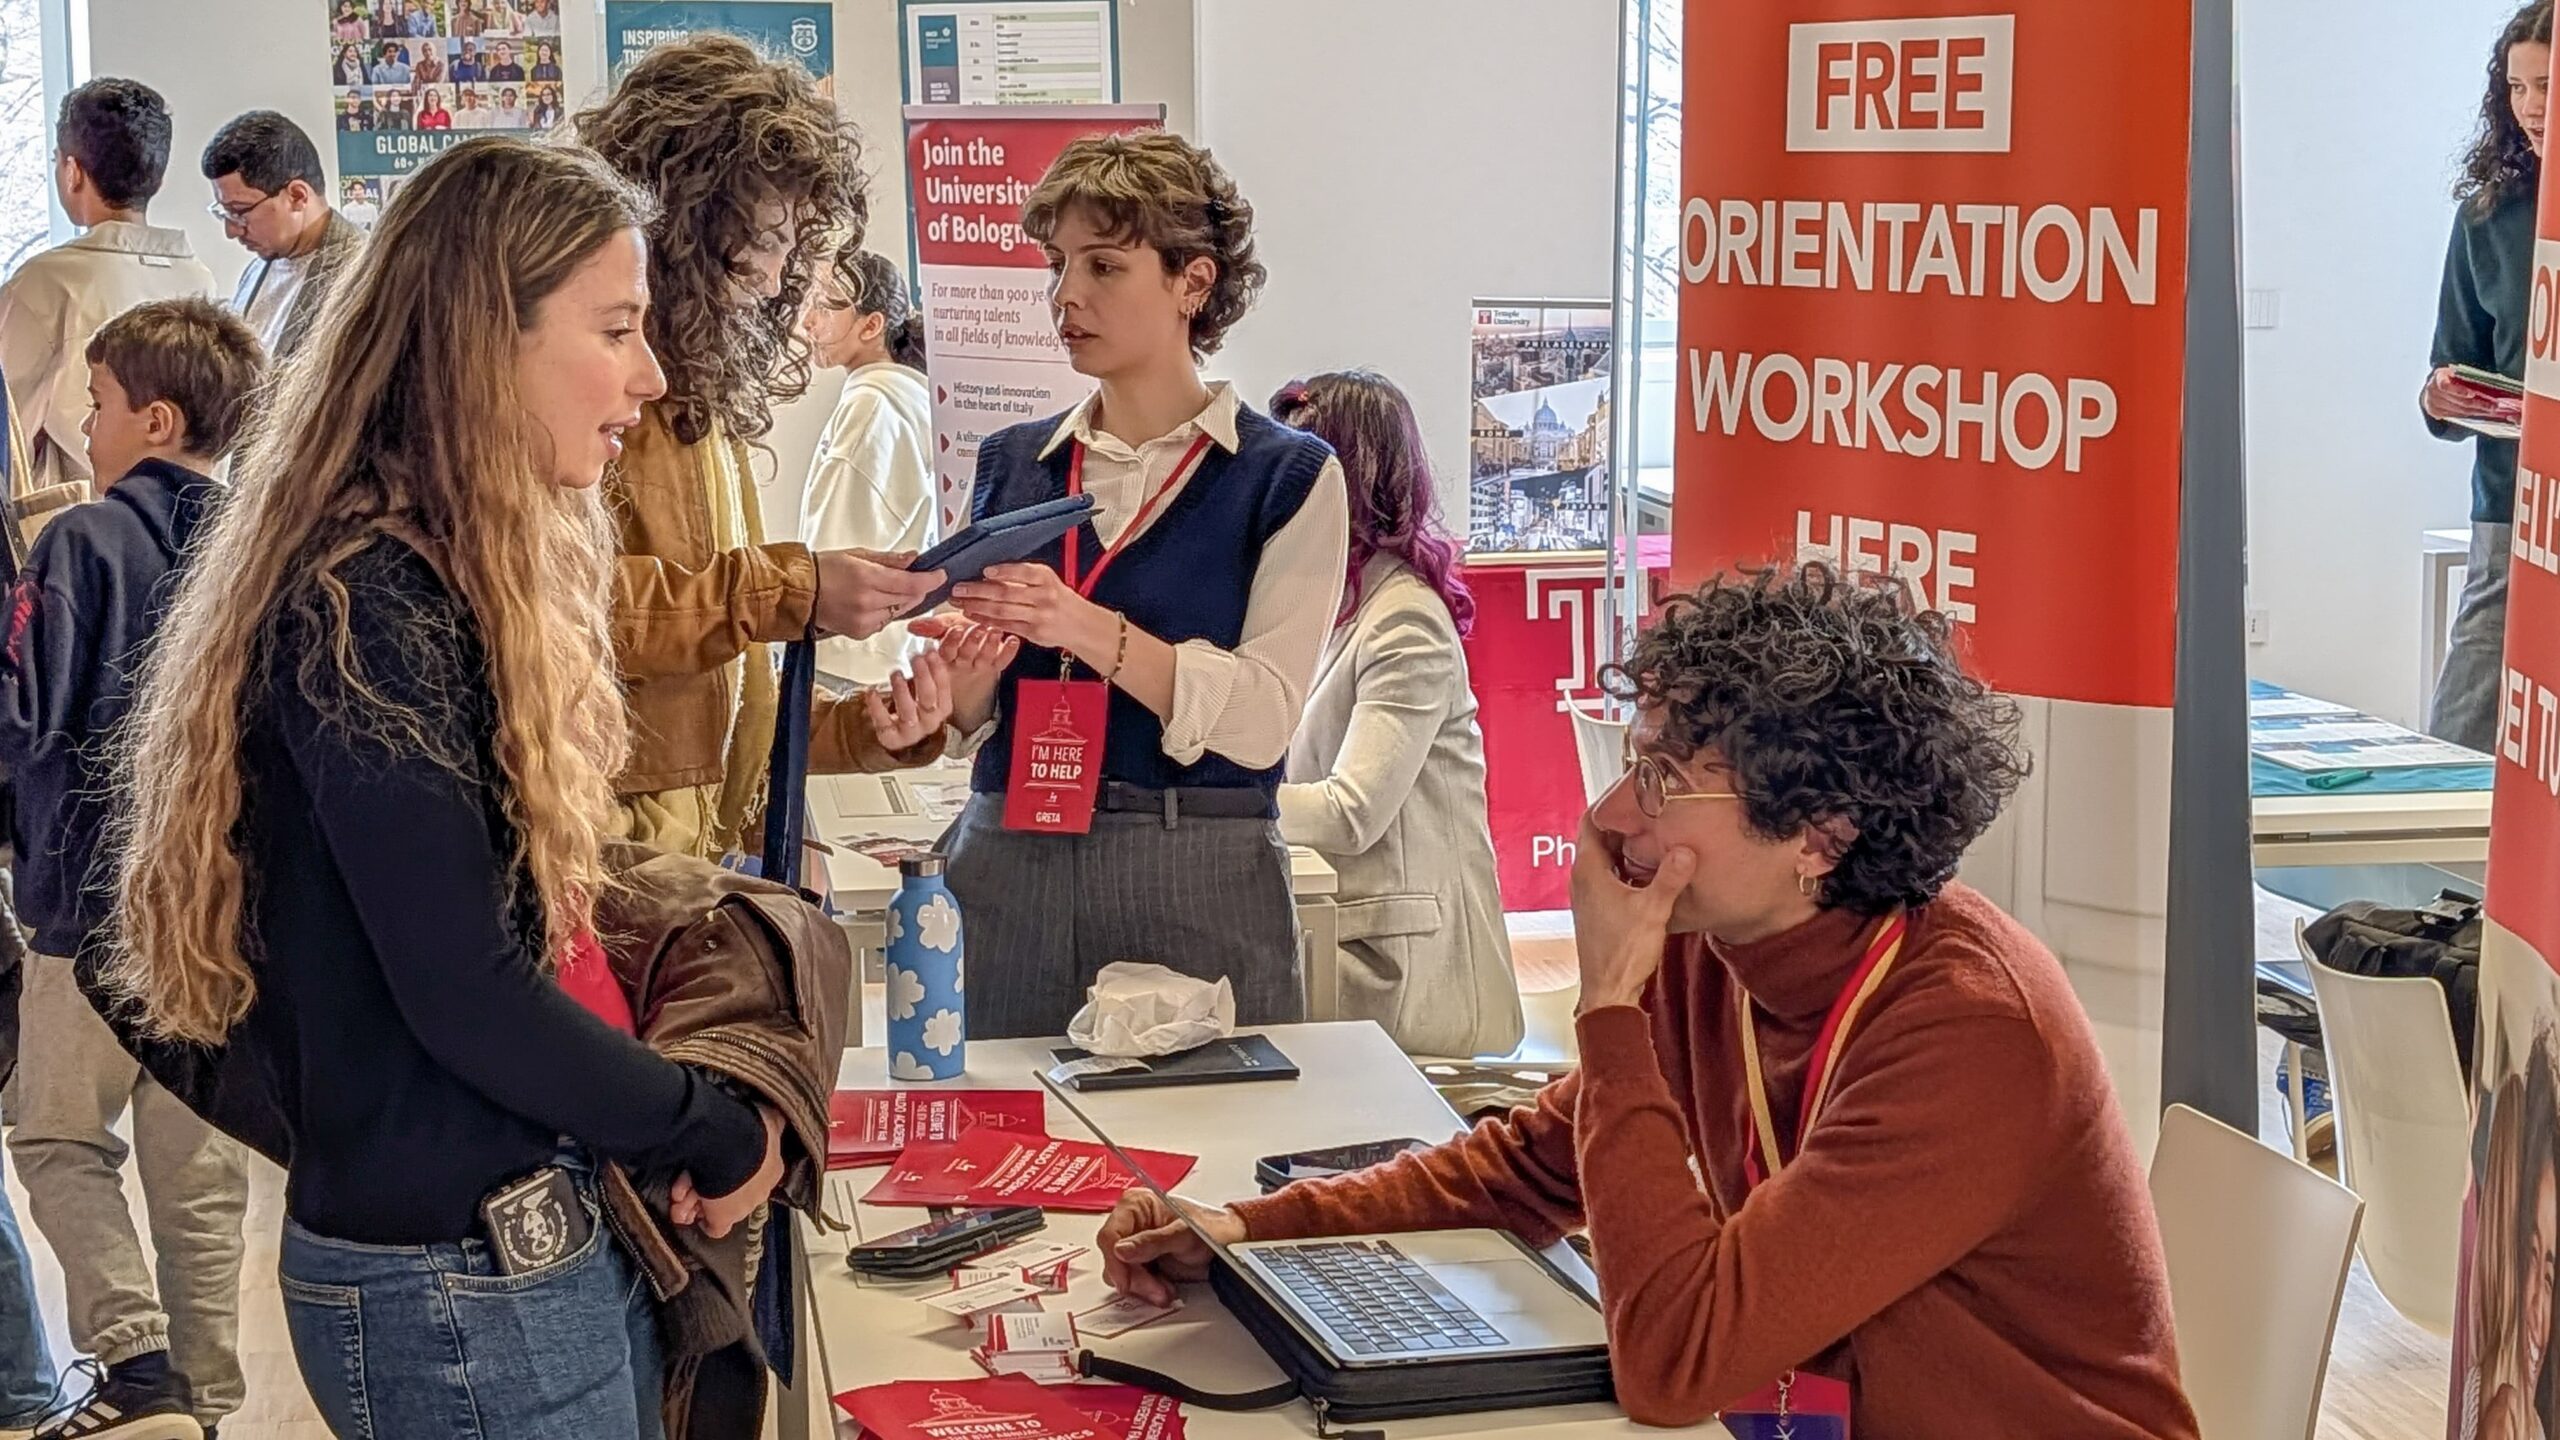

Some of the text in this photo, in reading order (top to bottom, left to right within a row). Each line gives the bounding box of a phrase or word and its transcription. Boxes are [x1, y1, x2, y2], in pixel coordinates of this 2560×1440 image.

[1816, 37, 1986, 132] FREE
[375, 135, 438, 154] GLOBAL
[922, 137, 1005, 171] Join the
[928, 214, 949, 243] of
[1681, 197, 2158, 305] ORIENTATION
[931, 283, 947, 299] For
[950, 286, 977, 300] more
[979, 284, 1004, 301] than
[1007, 290, 1029, 304] 900
[932, 307, 1021, 325] nurturing talents
[1493, 310, 1520, 318] Temple
[934, 325, 1065, 352] in all fields of knowledg
[1525, 340, 1611, 349] PHILADELPHIA
[953, 382, 1051, 399] History and innovation
[963, 398, 977, 410] the
[978, 399, 1002, 412] heart
[1003, 399, 1013, 412] of
[1013, 401, 1034, 416] Italy
[1689, 349, 2118, 472] WORKSHOP
[1031, 744, 1084, 762] I'M HERE
[1030, 762, 1082, 780] TO HELP
[926, 1419, 1042, 1438] WELCOME TO
